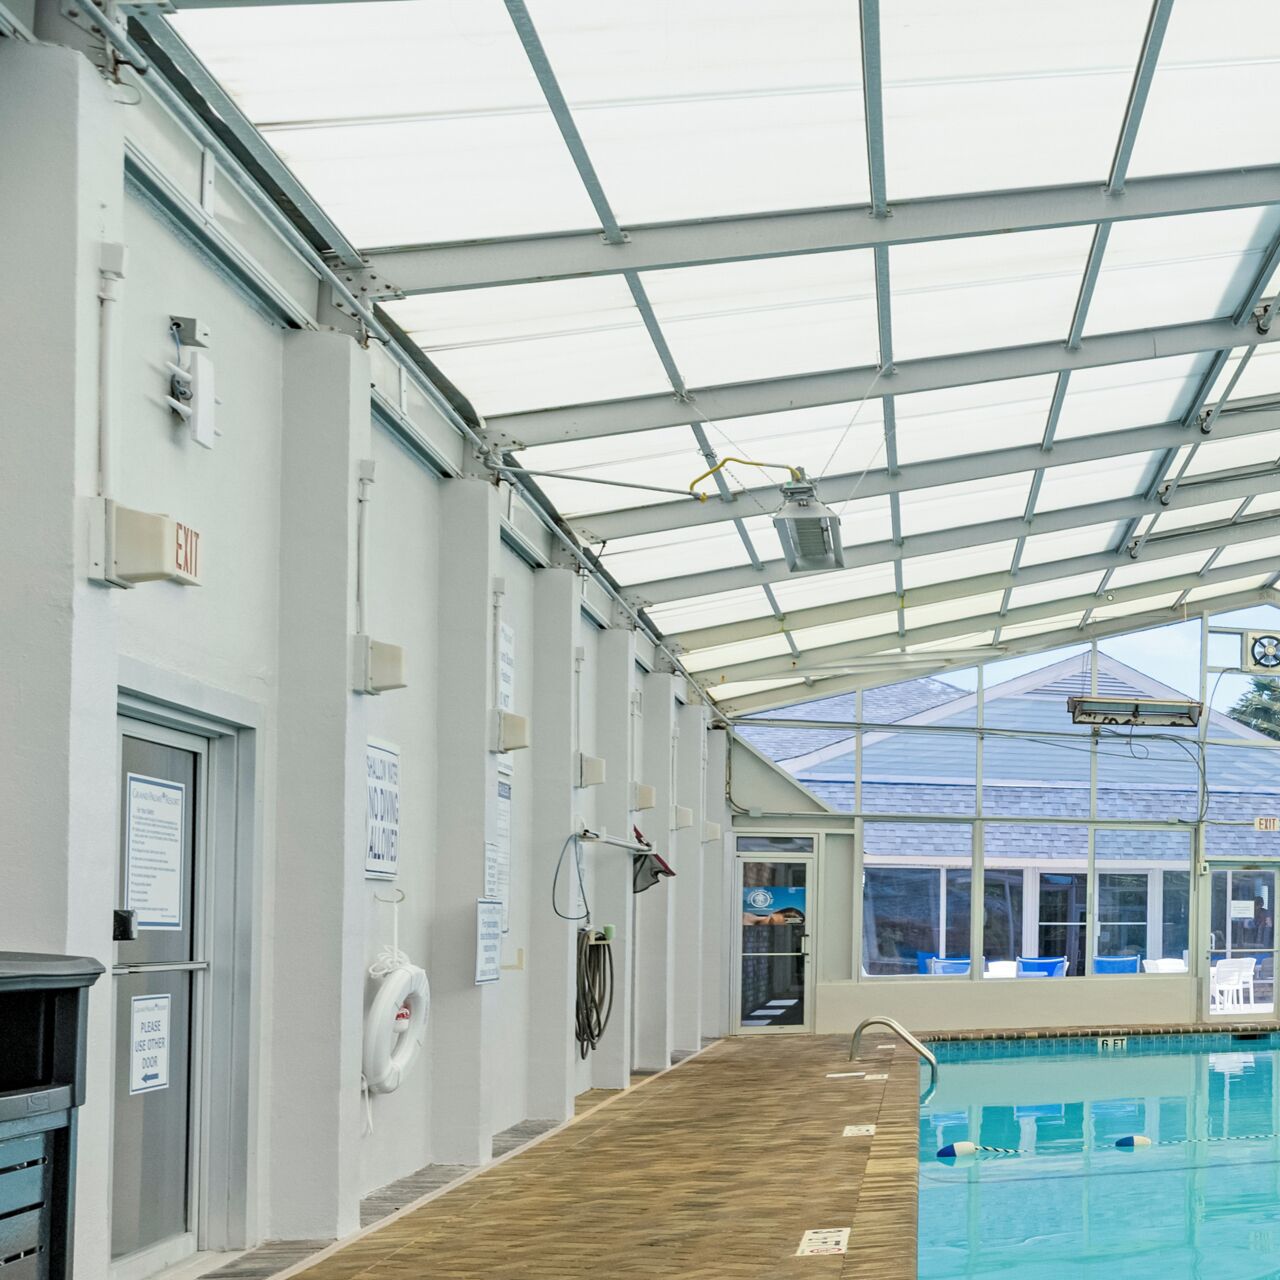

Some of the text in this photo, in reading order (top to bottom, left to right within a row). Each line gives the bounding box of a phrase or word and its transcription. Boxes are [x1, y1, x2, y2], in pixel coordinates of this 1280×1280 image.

[176, 522, 200, 577] EXIT
[369, 785, 399, 825] NO DIVING
[1259, 818, 1276, 830] EXIT
[368, 826, 397, 862] ALLOWED
[141, 1020, 161, 1033] PLEASE
[134, 1037, 166, 1052] USE OTHER
[1113, 1038, 1125, 1050] FT
[142, 1056, 158, 1069] DOOR
